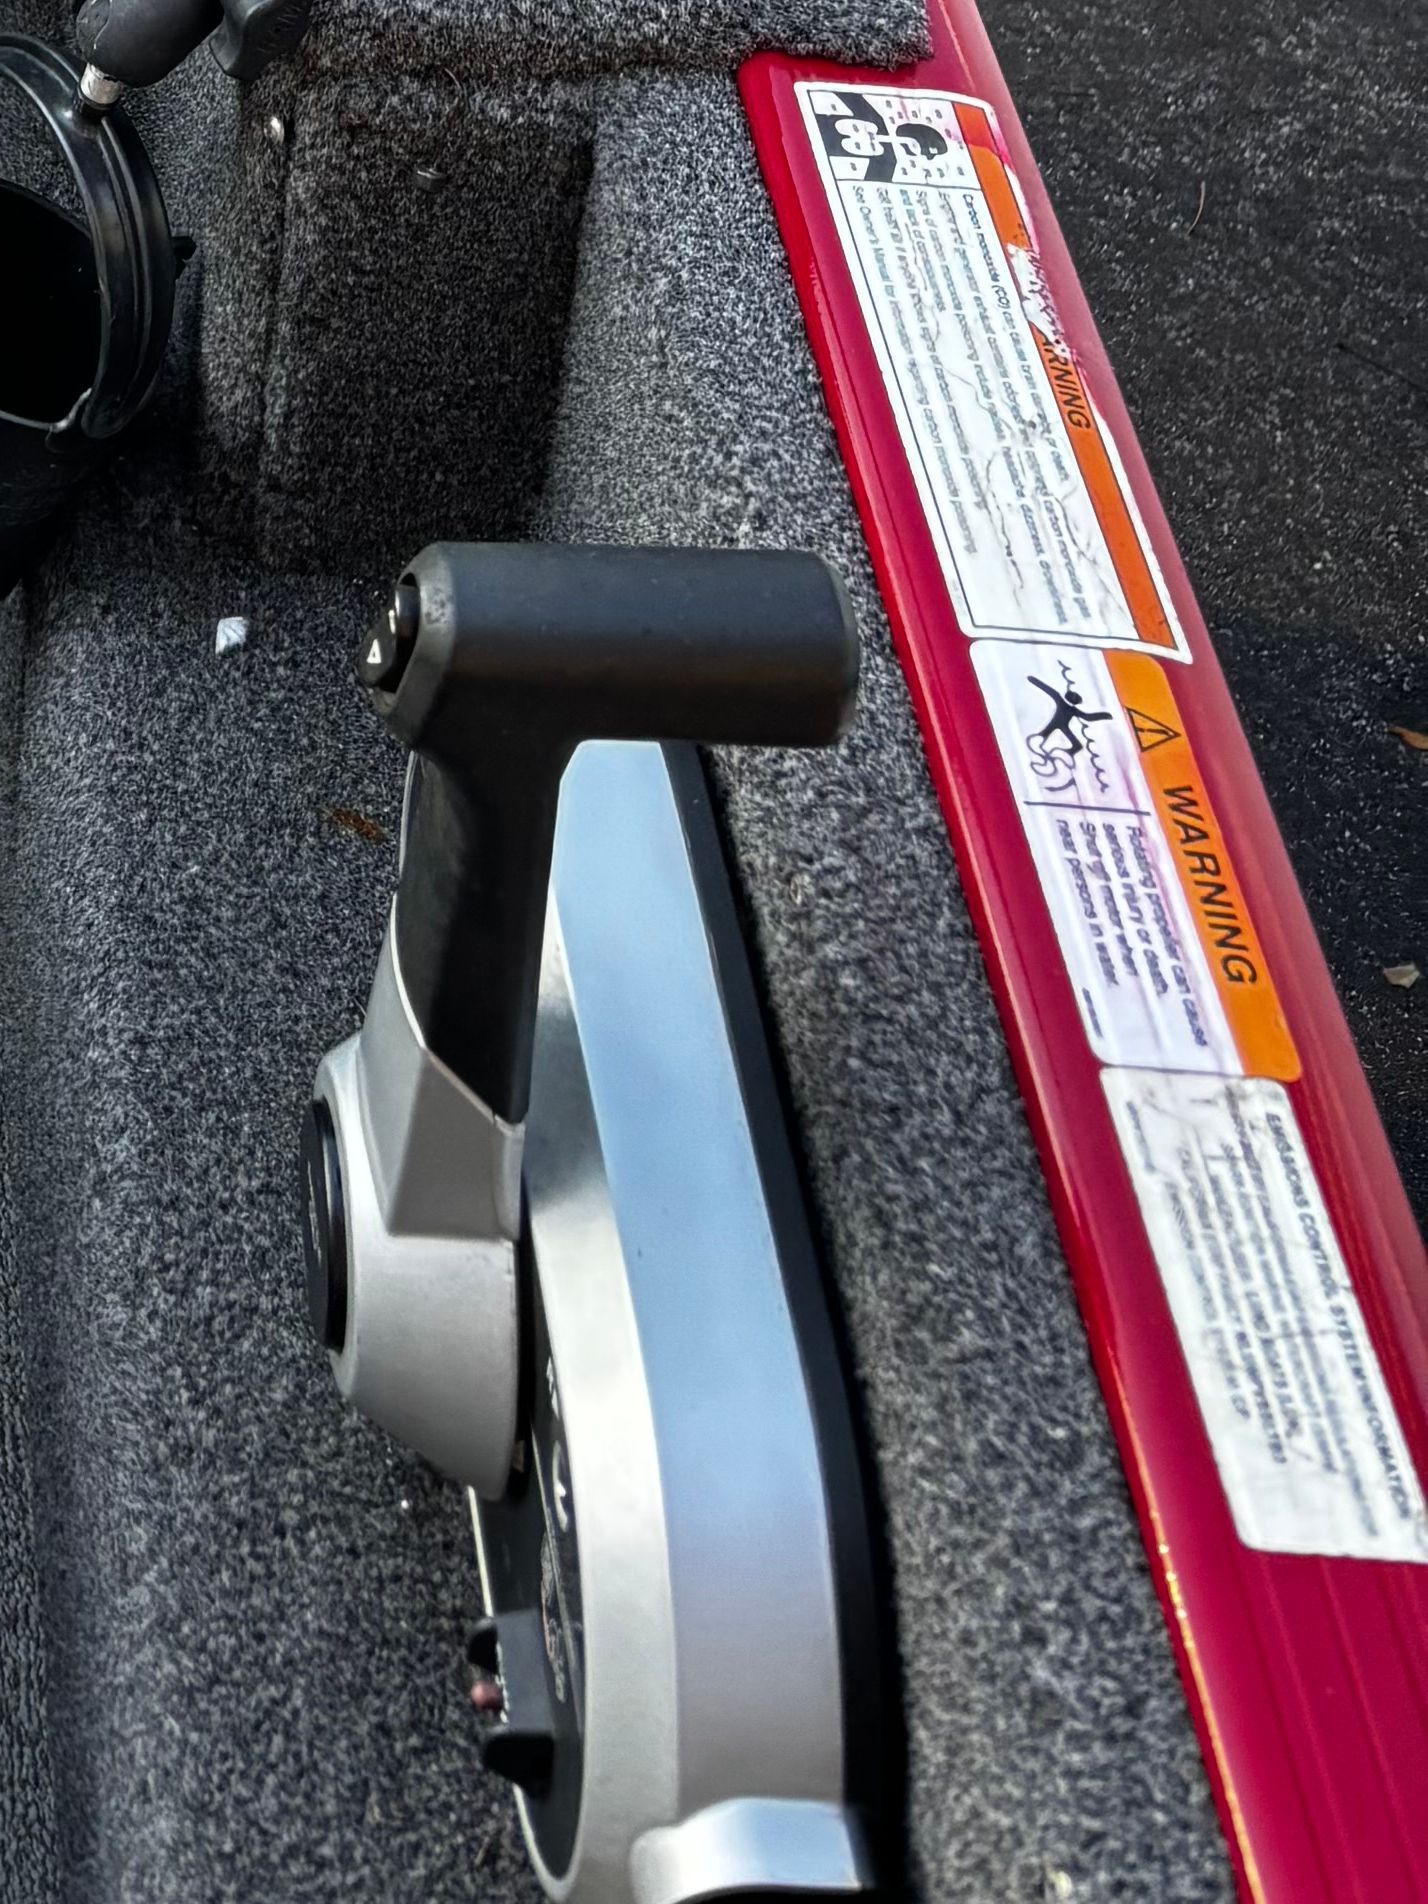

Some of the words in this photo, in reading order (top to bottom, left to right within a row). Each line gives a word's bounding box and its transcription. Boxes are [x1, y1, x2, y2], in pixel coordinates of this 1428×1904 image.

[1055, 819, 1079, 853] near
[1063, 857, 1099, 918] persons
[1100, 823, 1133, 878] serious
[1135, 928, 1152, 944] or
[1160, 784, 1259, 984] WARNING
[1088, 923, 1105, 937] in
[1098, 884, 1126, 930] motor
[1114, 934, 1142, 976] when
[1121, 826, 1160, 888] Rotating
[1144, 892, 1182, 961] propeller
[1170, 964, 1192, 994] can
[1181, 998, 1209, 1047] cause
